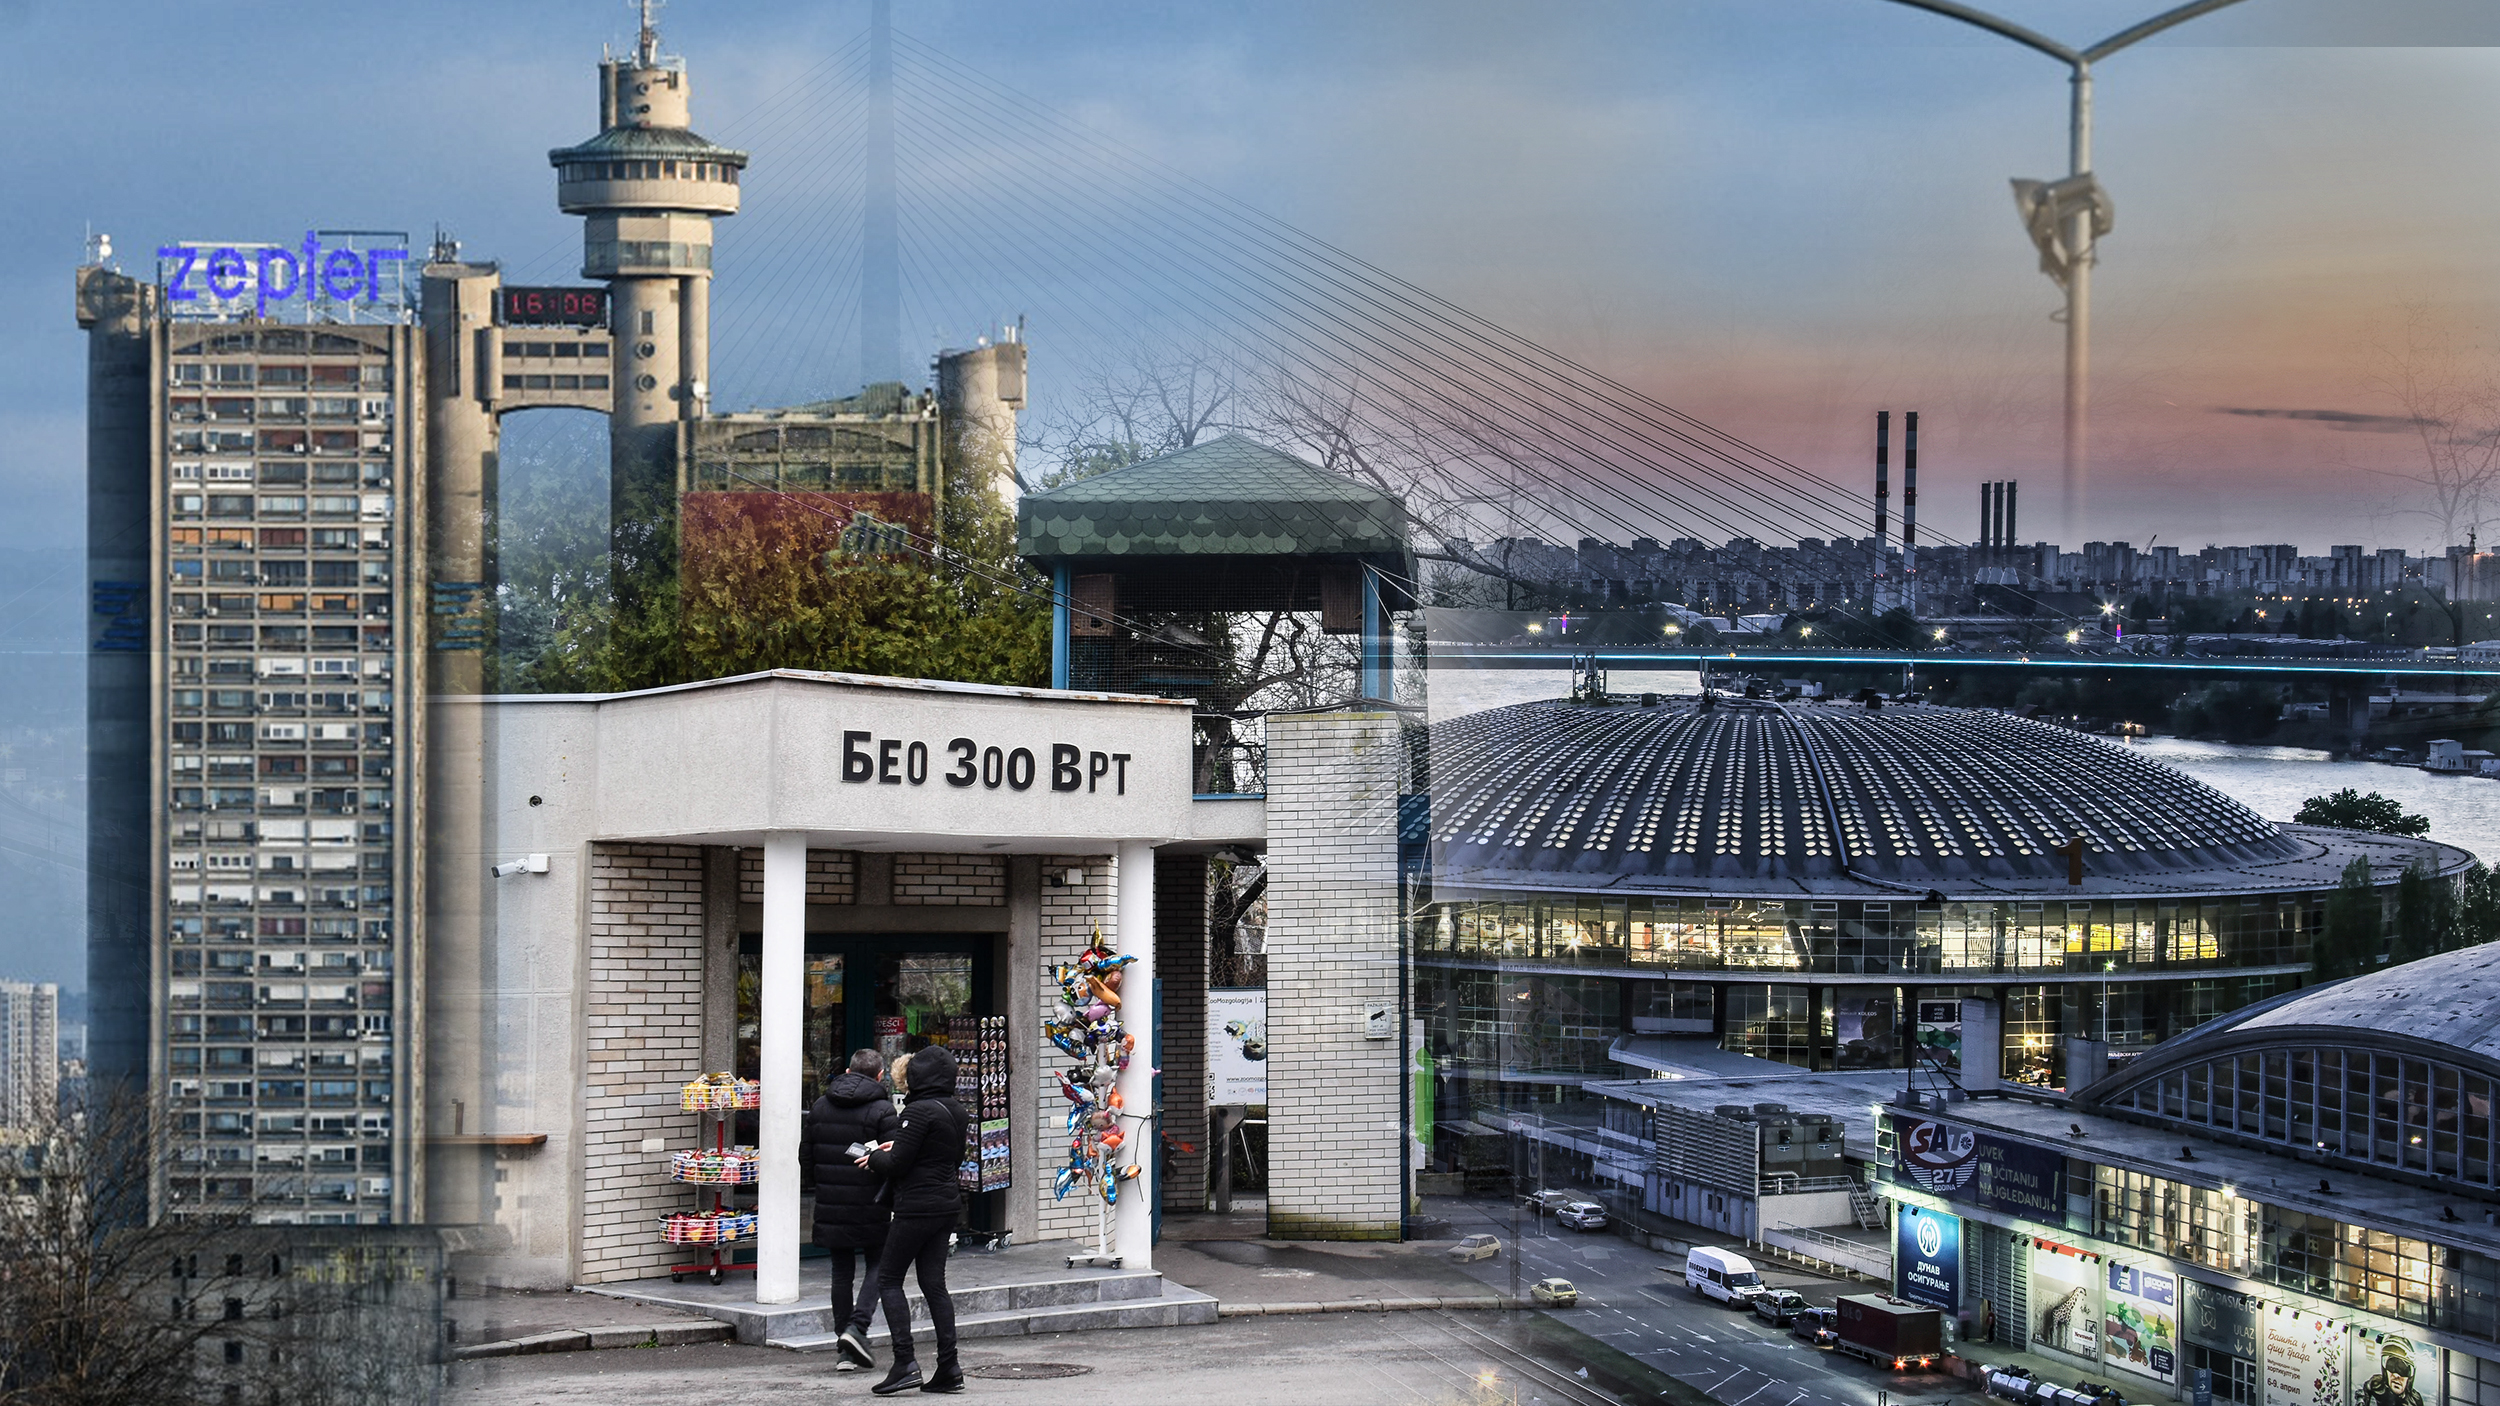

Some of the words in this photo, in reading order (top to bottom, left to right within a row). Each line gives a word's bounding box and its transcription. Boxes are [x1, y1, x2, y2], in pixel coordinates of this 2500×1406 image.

[158, 230, 409, 318] zepter
[1050, 742, 1132, 796] ВРТ
[1978, 1145, 2005, 1162] UVEK
[1932, 1168, 1955, 1185] 27
[1978, 1162, 2039, 1189] NAJČITANIJI
[1933, 1183, 1957, 1192] GODINA
[1917, 1261, 1940, 1276] ДУНАВ
[1907, 1271, 1950, 1292] ОСИГУРАЊЕ
[2186, 1283, 2214, 1303] SALON
[2233, 1324, 2255, 1340] ULAZ
[2267, 1377, 2279, 1389] 6-9.
[2280, 1382, 2301, 1395] април
